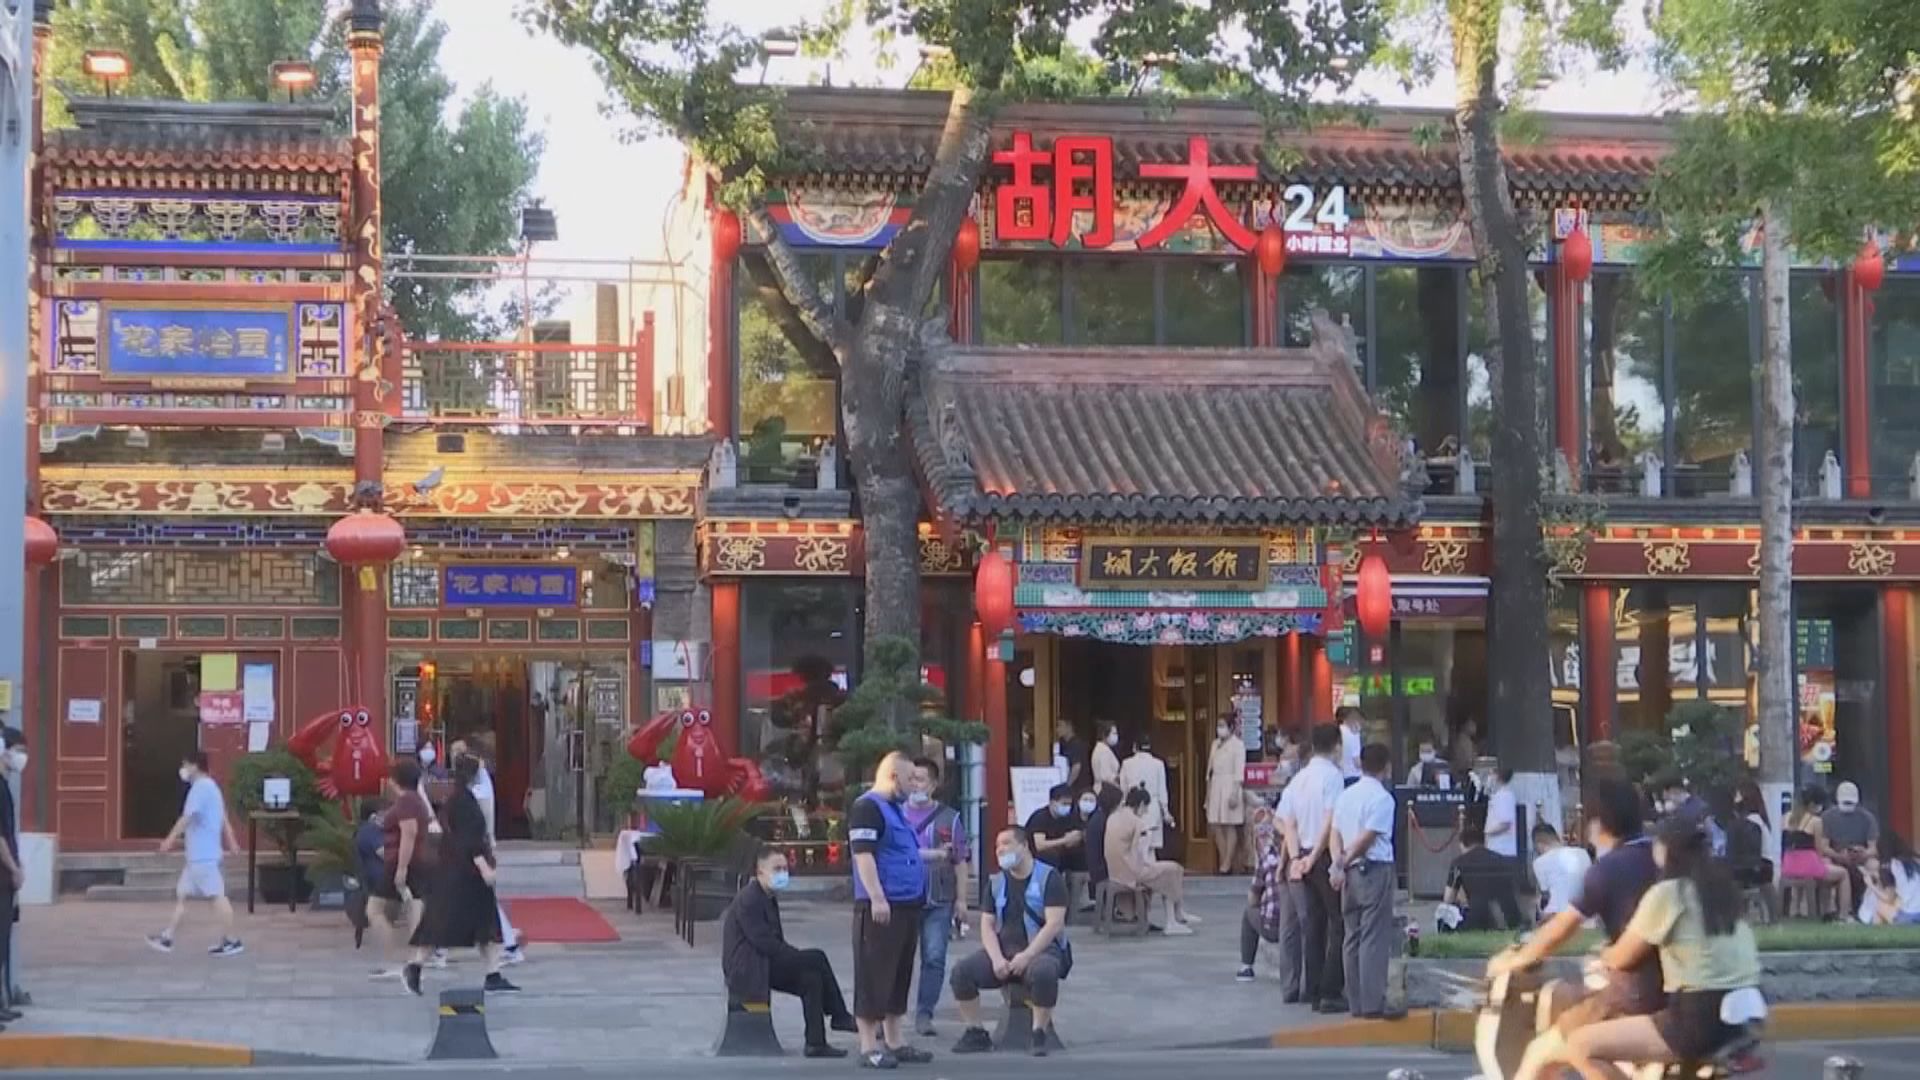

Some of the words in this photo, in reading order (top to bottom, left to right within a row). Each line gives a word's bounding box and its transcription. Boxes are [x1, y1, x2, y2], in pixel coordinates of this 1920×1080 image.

[992, 132, 1261, 250] 胡大
[1283, 184, 1349, 233] 24
[1286, 234, 1348, 254] 小时营业
[1390, 598, 1440, 614] 取号处
